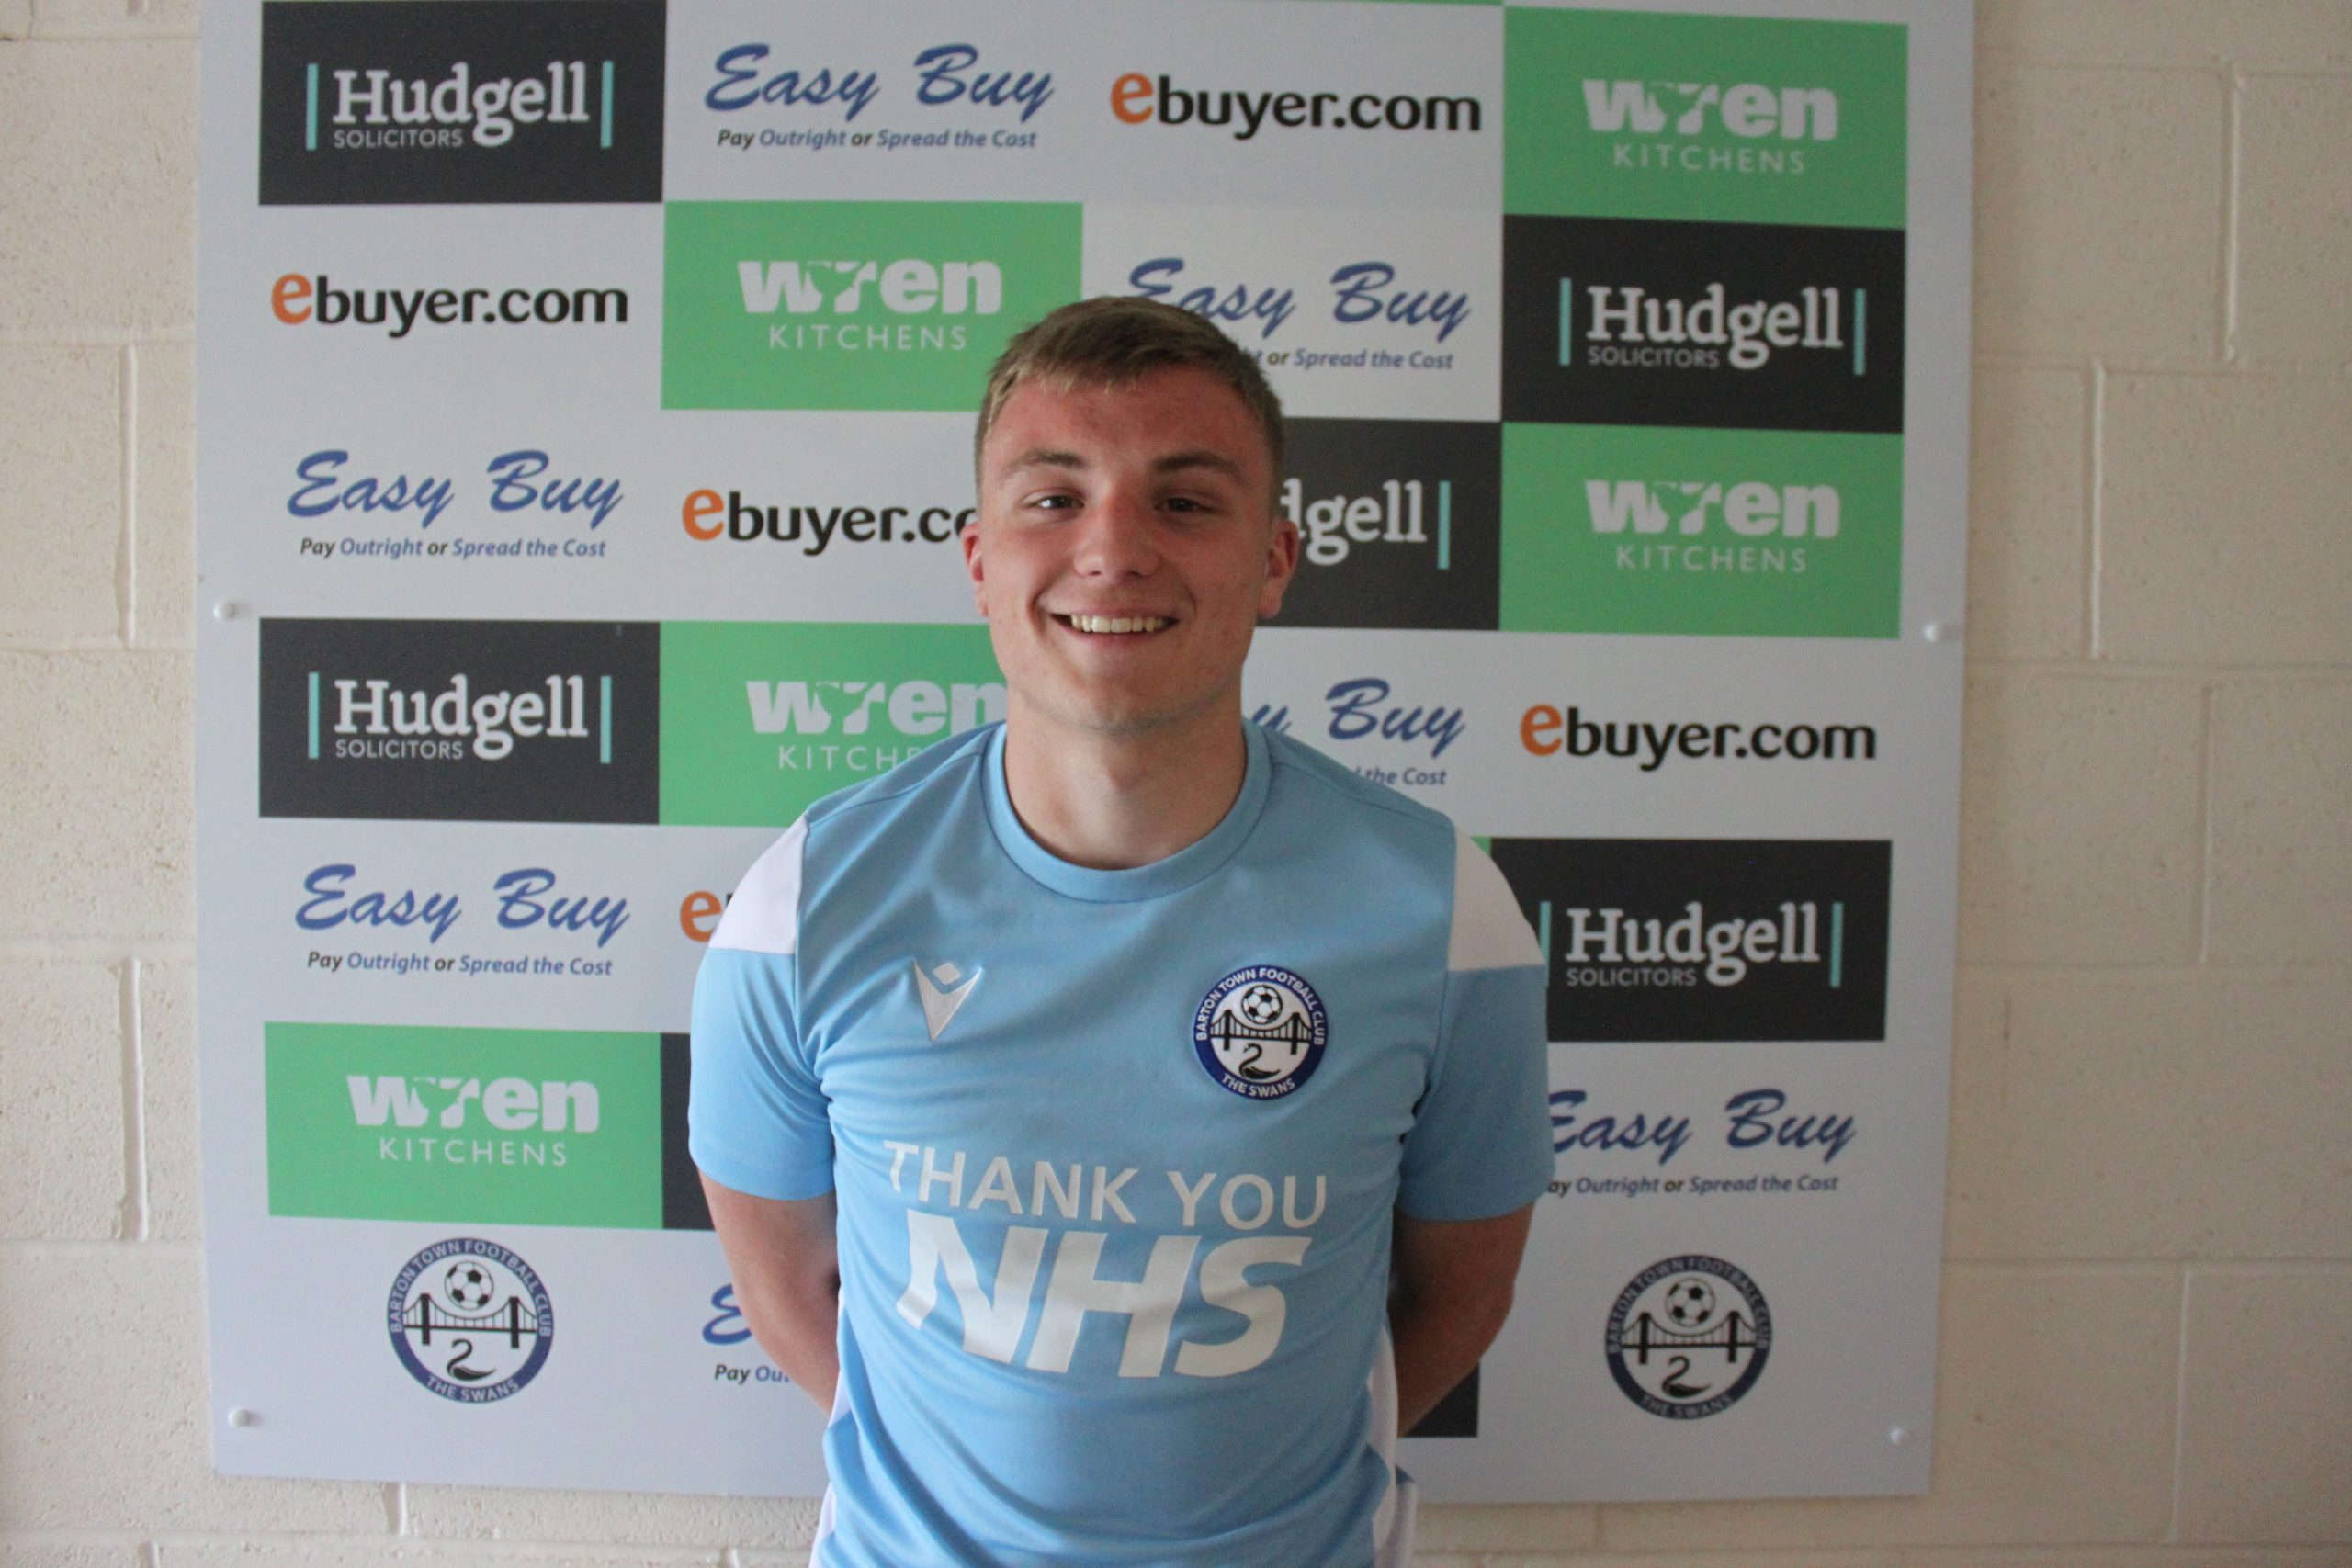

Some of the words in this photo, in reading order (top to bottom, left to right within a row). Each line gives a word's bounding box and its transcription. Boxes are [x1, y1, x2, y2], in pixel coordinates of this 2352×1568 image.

[333, 61, 589, 147] Hudgell
[705, 43, 879, 122] Easy
[914, 43, 1054, 123] Buy
[1111, 73, 1481, 140] ebuyer.com
[1582, 79, 1838, 141] wren
[334, 128, 463, 149] SOLICITORS
[718, 129, 753, 151] Pay
[759, 129, 845, 151] Outright
[851, 132, 872, 147] or
[876, 130, 949, 149] Spread
[954, 130, 987, 148] the
[992, 130, 1036, 148] Cost
[1613, 143, 1805, 174] KITCHENS
[271, 273, 628, 338] ebuyer.com
[738, 259, 1002, 314] wren
[1330, 262, 1472, 343] Buy
[769, 324, 967, 354] KITCHENS
[1587, 282, 1843, 369] Hudgell
[1268, 353, 1289, 366] or
[1295, 348, 1366, 369] Spread
[1372, 350, 1404, 367] the
[1409, 350, 1453, 368] Cost
[1588, 345, 1719, 367] SOLICITORS
[288, 450, 454, 529] Easy
[487, 449, 623, 529] Buy
[1585, 479, 1840, 537] wren
[300, 537, 335, 558] Pay
[340, 538, 423, 559] Outright
[427, 542, 447, 556] or
[452, 539, 520, 559] Spread
[526, 540, 558, 557] the
[563, 540, 606, 558] Cost
[682, 488, 976, 557] ebuyer.c
[1280, 478, 1427, 565] gell
[1616, 545, 1807, 572] KITCHENS
[334, 674, 588, 760] Hudgell
[1326, 678, 1465, 759] Buy
[1520, 704, 1877, 773] ebuyer.com
[335, 739, 464, 760] SOLICITORS
[778, 746, 922, 771] KITCH
[1403, 767, 1447, 785] Cost
[295, 864, 461, 944] Easy
[492, 868, 630, 948] Buy
[307, 951, 343, 971] Pay
[347, 953, 430, 975] Outright
[434, 958, 455, 971] or
[459, 954, 529, 976] Spread
[533, 957, 564, 975] the
[570, 958, 613, 976] Cost
[1566, 901, 1819, 986] Hudgell
[1566, 967, 1696, 987] SOLICITORS
[1196, 991, 1221, 1041] BARTON
[1218, 969, 1256, 992] TOWN
[1259, 968, 1317, 1010] FOOTBALL
[1313, 1011, 1325, 1045] CLUB
[347, 1075, 599, 1132] wren
[1222, 1073, 1247, 1092] THE
[1249, 1078, 1295, 1097] SWANS
[379, 1138, 567, 1166] KITCHENS
[1724, 1089, 1856, 1164] Buy
[883, 1140, 1138, 1224] THANK
[1167, 1170, 1326, 1231] YOU
[1548, 1181, 1572, 1198] ay
[1577, 1178, 1659, 1198] Outright
[1664, 1180, 1685, 1193] or
[1689, 1177, 1757, 1196] Spread
[1761, 1176, 1792, 1193] the
[1797, 1176, 1838, 1193] Cost
[390, 1269, 414, 1333] BARTON
[412, 1240, 459, 1270] TOWN
[464, 1239, 539, 1293] FOOTBALL
[534, 1293, 551, 1337] CLUB
[896, 1208, 1313, 1378] NHS
[427, 1376, 457, 1397] THE
[460, 1379, 521, 1402] SWANS
[714, 1364, 750, 1385] Pay
